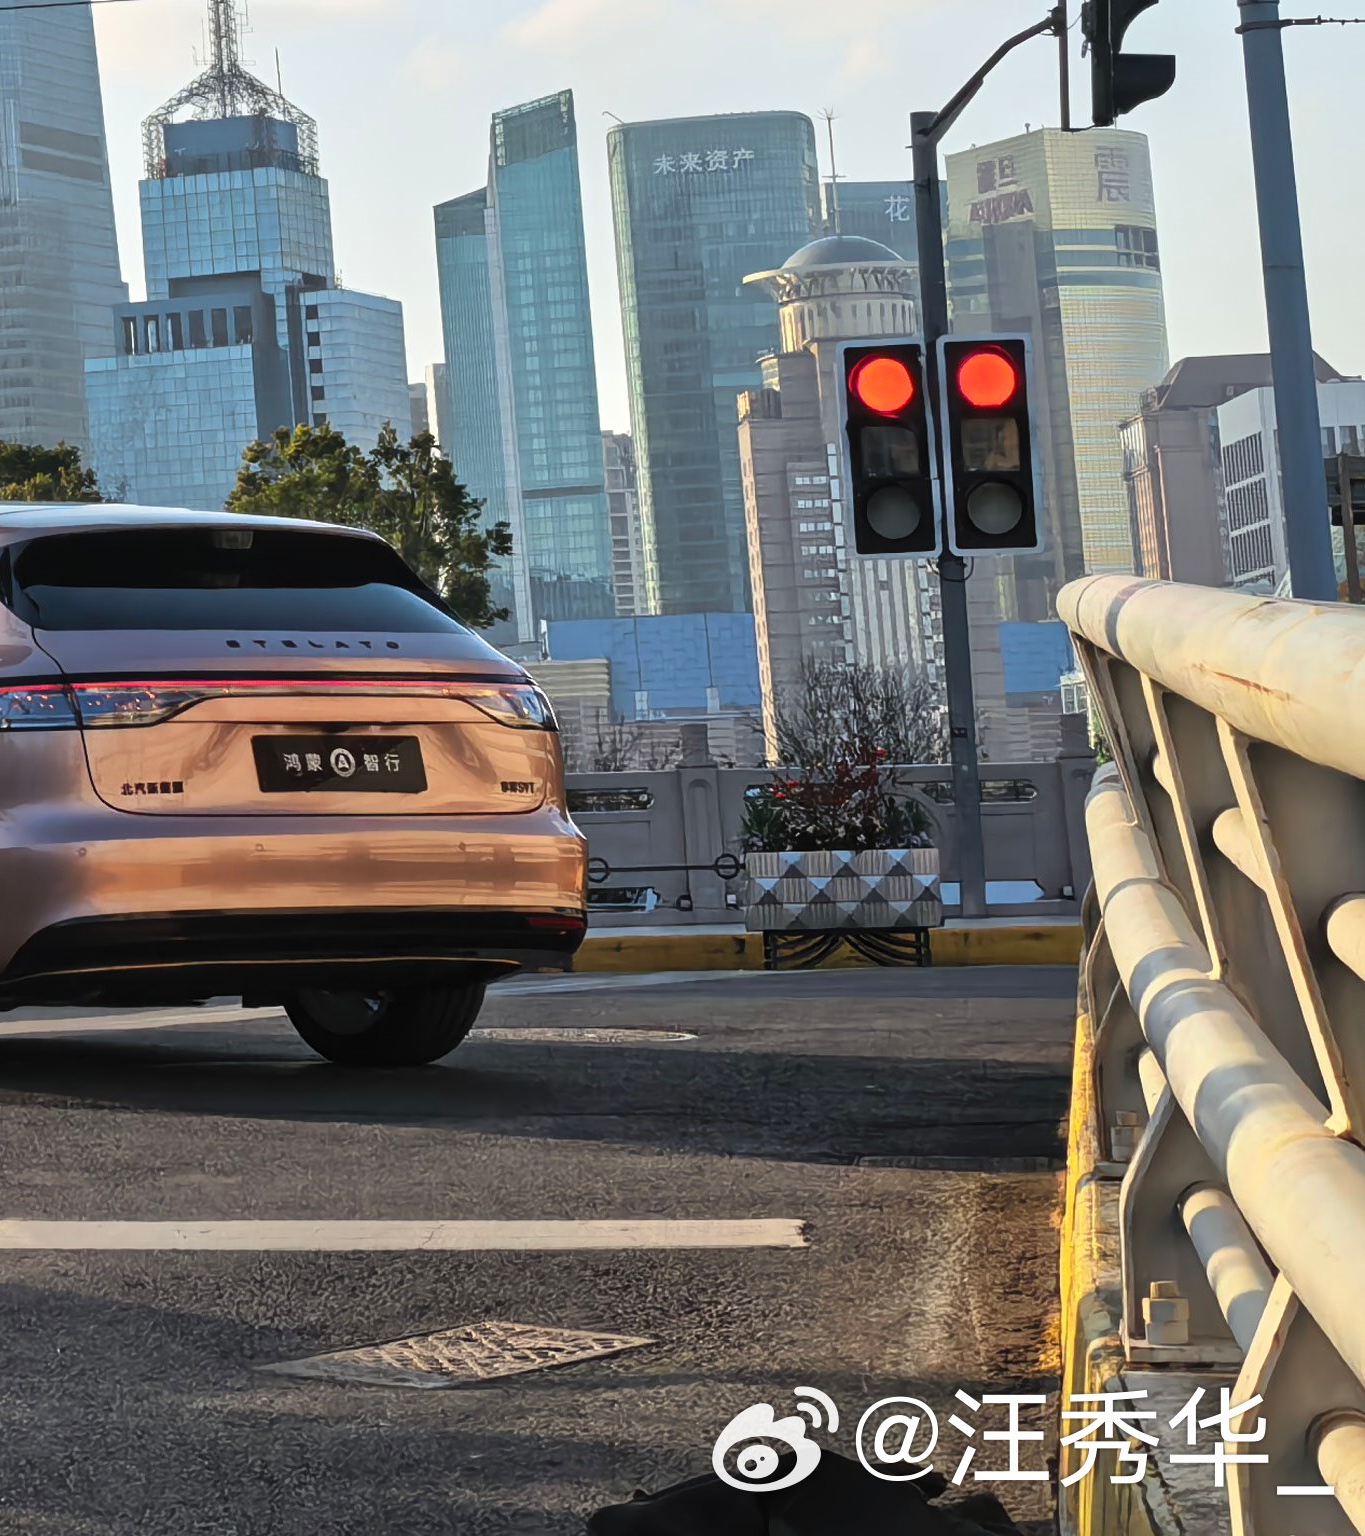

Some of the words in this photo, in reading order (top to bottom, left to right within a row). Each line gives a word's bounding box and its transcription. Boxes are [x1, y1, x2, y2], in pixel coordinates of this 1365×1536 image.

[653, 147, 755, 175] 未来资产
[884, 195, 910, 222] 花
